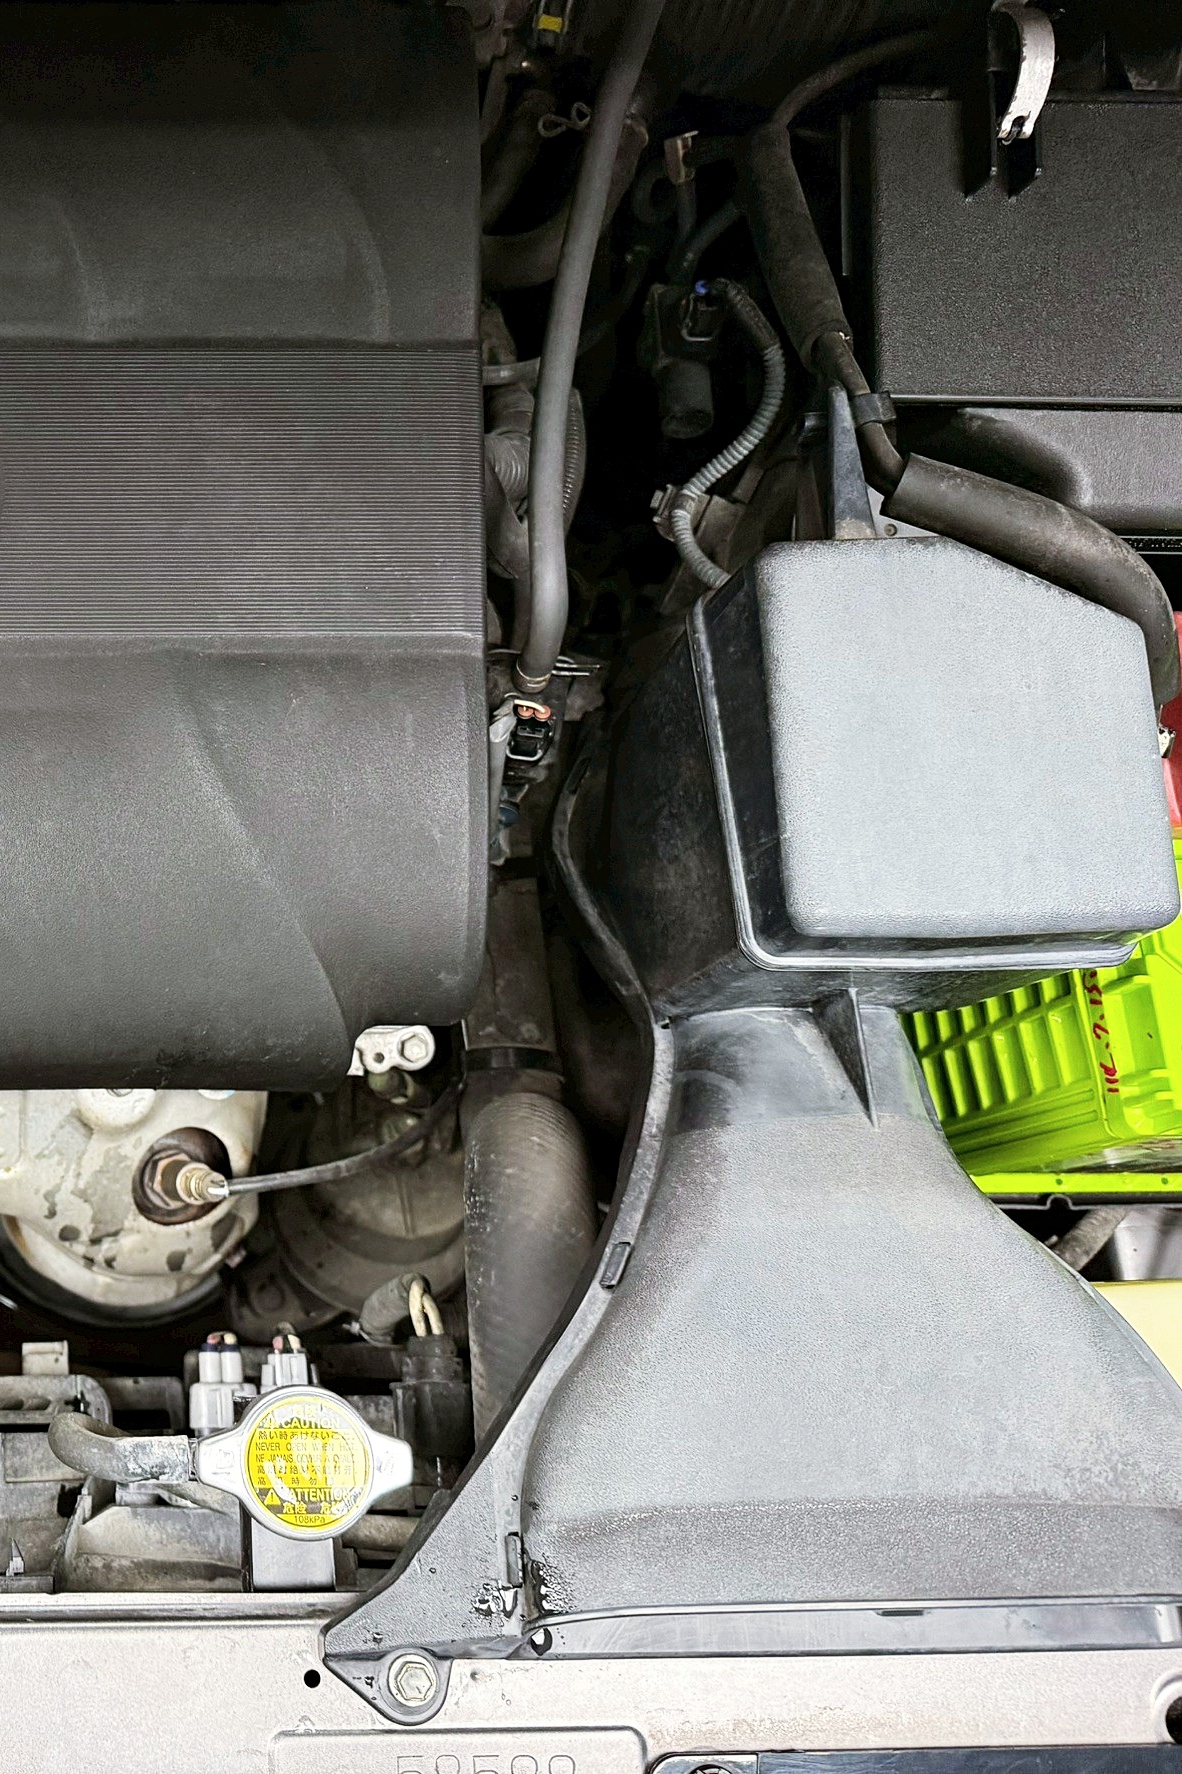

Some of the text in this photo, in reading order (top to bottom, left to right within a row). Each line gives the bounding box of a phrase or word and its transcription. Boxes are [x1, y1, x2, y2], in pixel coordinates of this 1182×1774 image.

[282, 1417, 339, 1429] CAUTION
[255, 1442, 281, 1451] NEVER
[285, 1442, 307, 1451] OPEN
[255, 1454, 265, 1463] NE
[289, 1488, 352, 1501] ATTENTION
[294, 1515, 326, 1524] 108kPa
